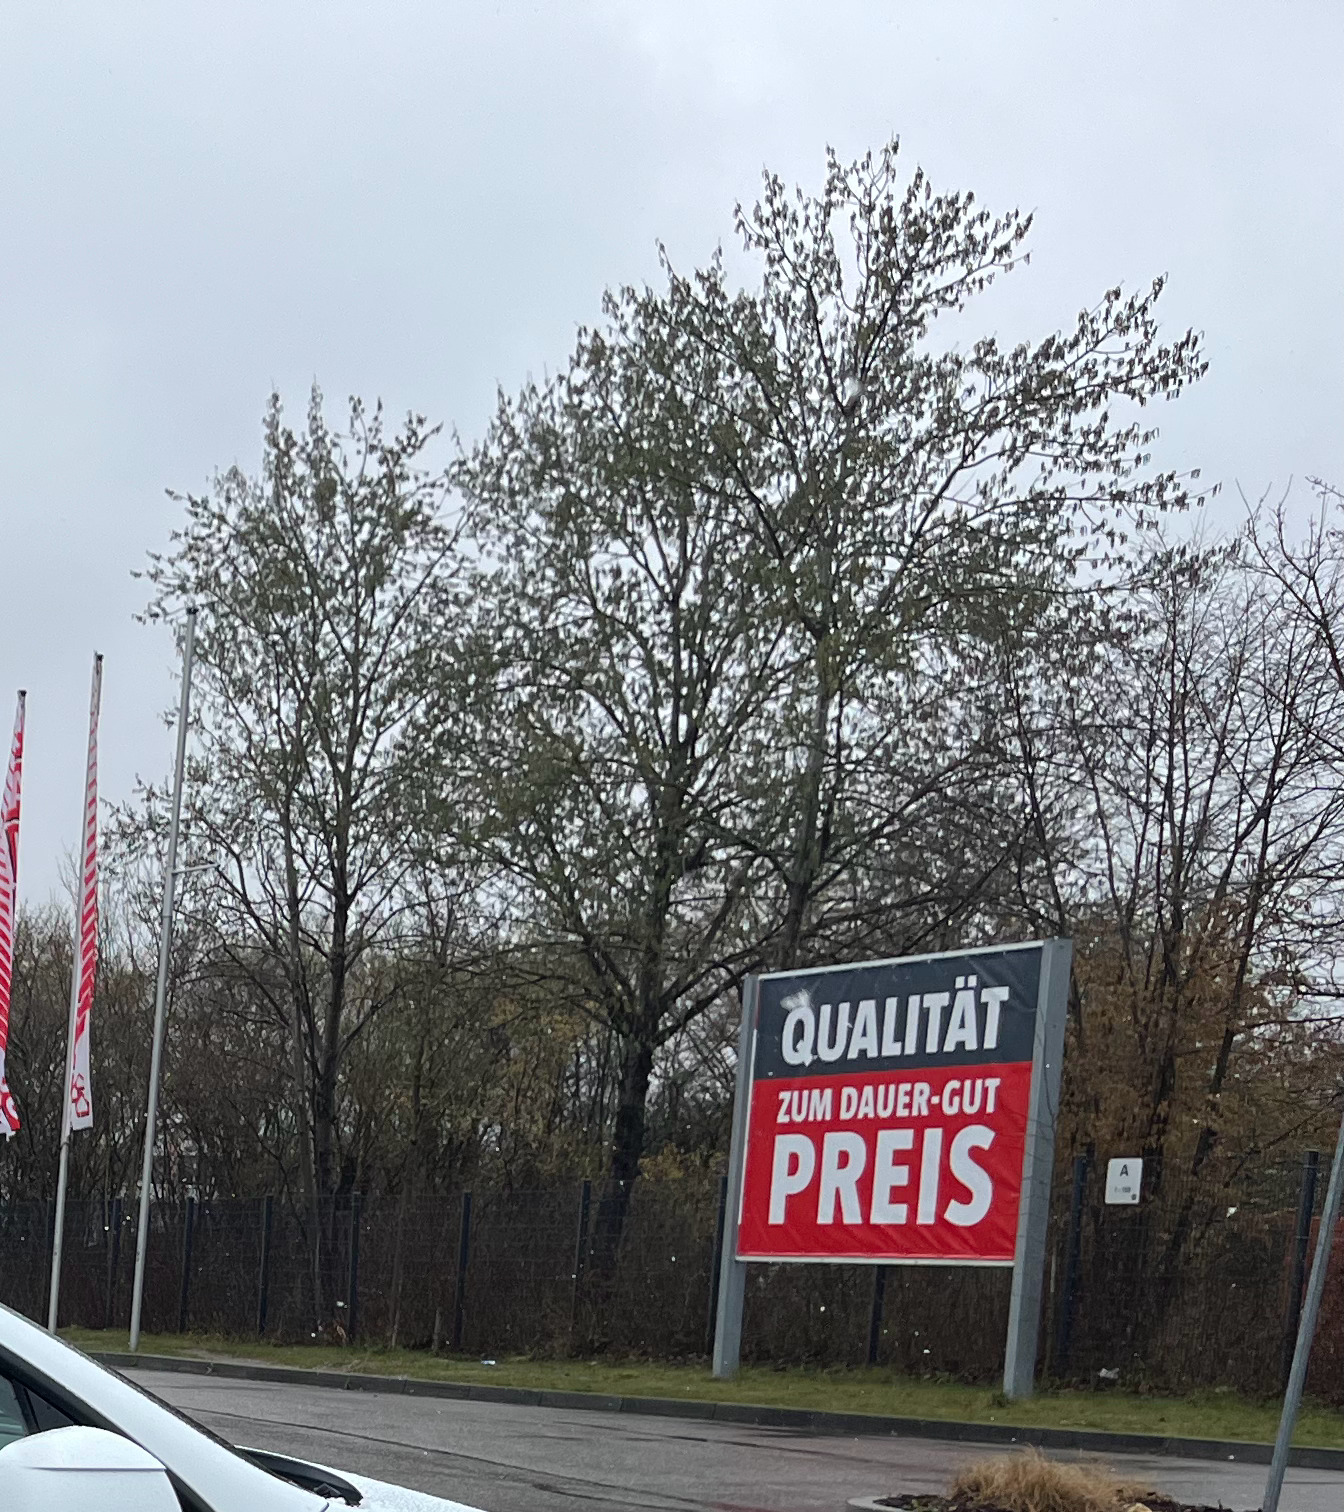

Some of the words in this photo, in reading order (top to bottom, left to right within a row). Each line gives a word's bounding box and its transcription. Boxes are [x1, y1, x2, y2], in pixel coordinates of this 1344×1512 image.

[781, 975, 1010, 1067] QUALITÄT
[776, 1088, 833, 1124] ZUM
[840, 1078, 1001, 1120] DAUER-GUT
[768, 1124, 996, 1227] PREIS
[1119, 1164, 1129, 1177] A
